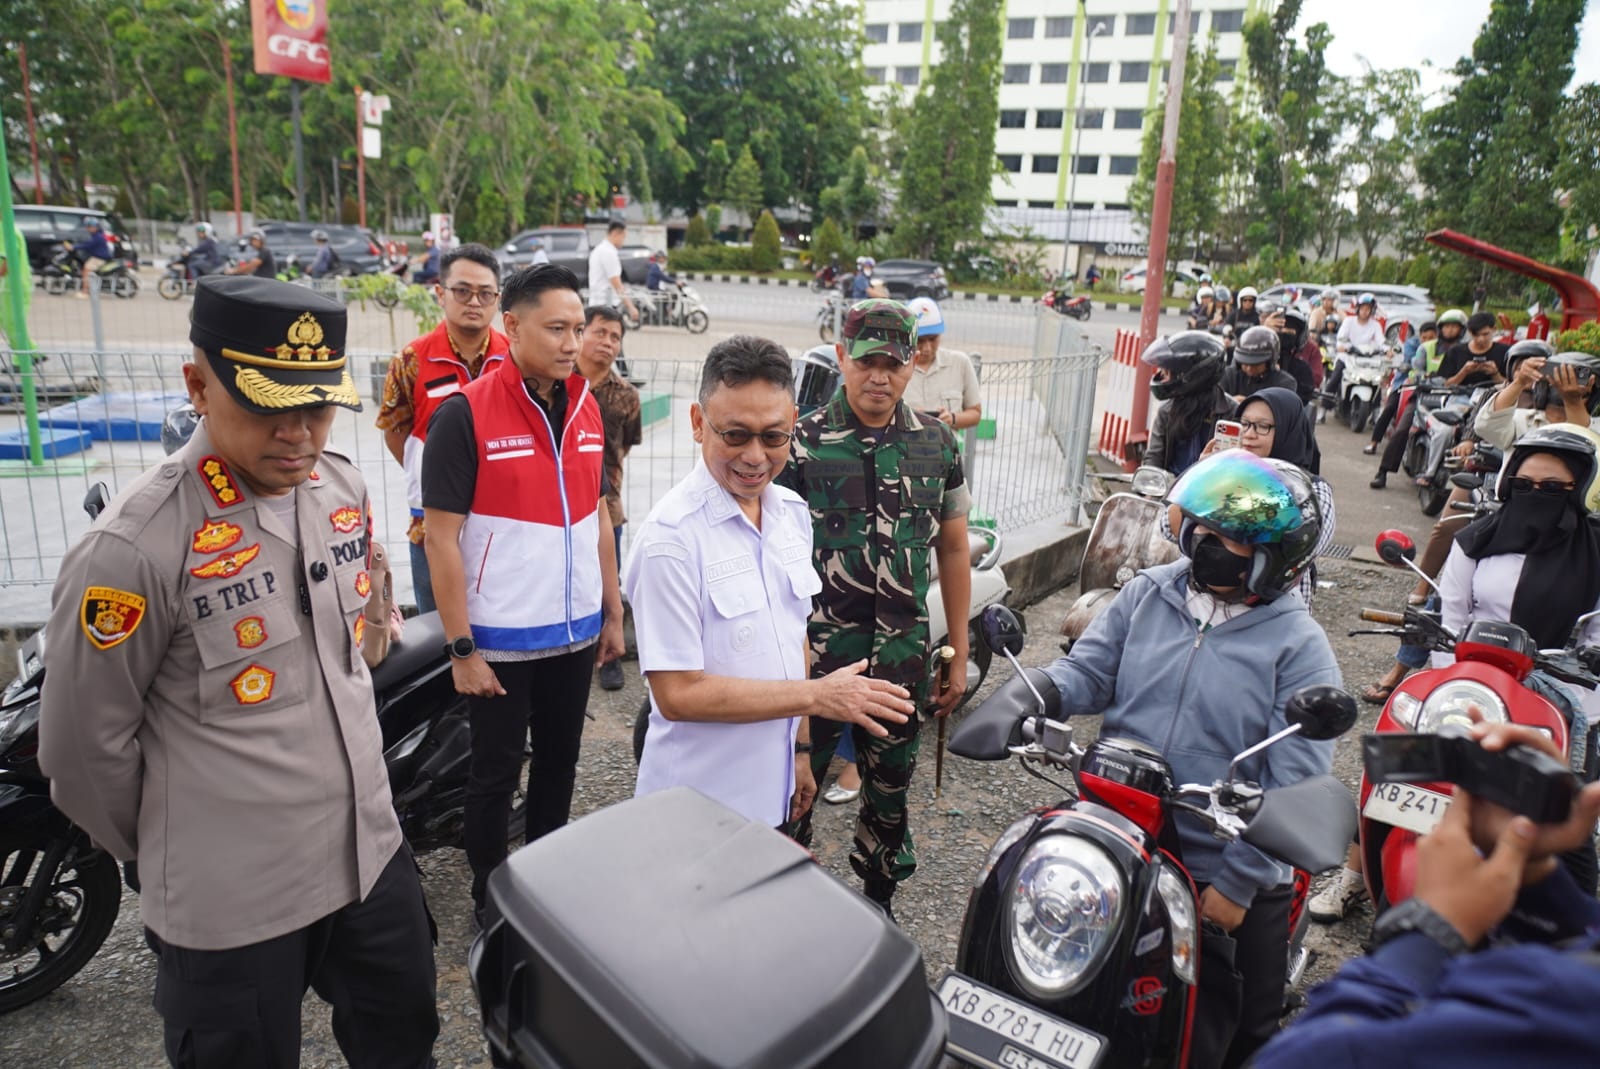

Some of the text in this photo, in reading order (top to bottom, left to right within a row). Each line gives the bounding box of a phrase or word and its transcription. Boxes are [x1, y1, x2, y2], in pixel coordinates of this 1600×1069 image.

[268, 34, 328, 65] CFC
[1117, 244, 1150, 256] MAC
[193, 571, 276, 619] E TRI P
[1095, 756, 1131, 775] HONDA
[1375, 783, 1450, 815] KB 241
[946, 986, 1084, 1063] KB 6781 HU
